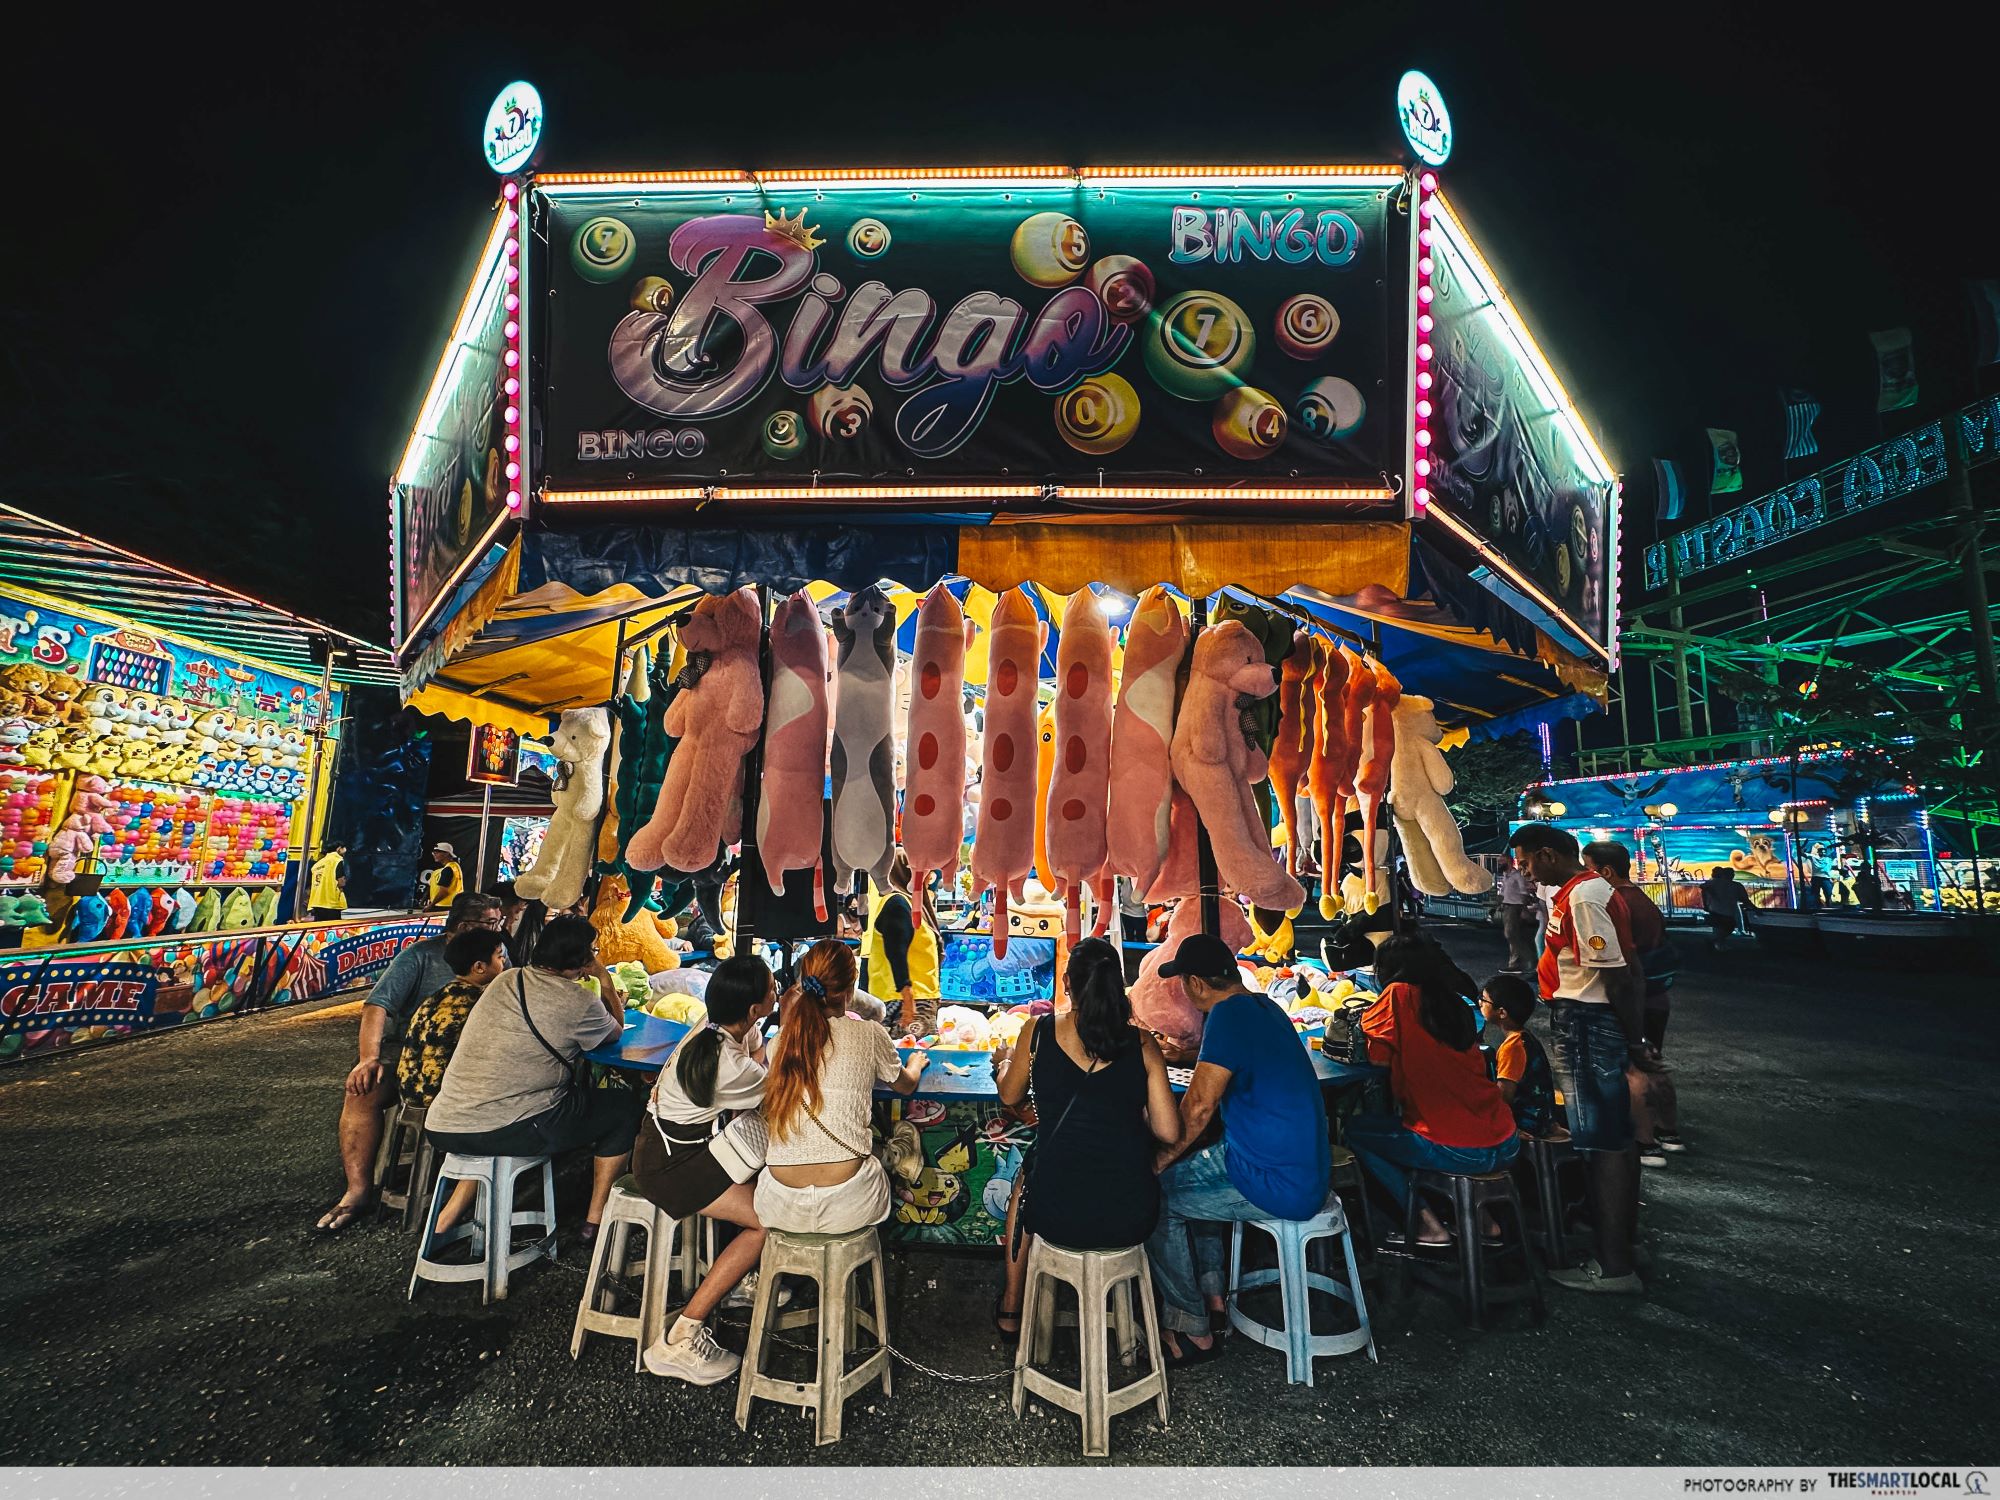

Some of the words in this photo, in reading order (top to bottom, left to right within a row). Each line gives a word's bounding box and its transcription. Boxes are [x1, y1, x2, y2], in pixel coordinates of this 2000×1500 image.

[601, 231, 613, 252] 7
[1071, 230, 1086, 258] 5
[1168, 206, 1361, 265] BINGO
[1116, 283, 1136, 308] 2
[1194, 313, 1217, 349] 7
[1300, 309, 1318, 331] 6
[608, 213, 1134, 458] Bingo
[774, 417, 790, 436] 9
[840, 412, 862, 438] 3
[1265, 414, 1280, 439] 4
[577, 427, 706, 461] BINGO
[337, 937, 399, 975] DART
[0, 980, 147, 1018] GAME
